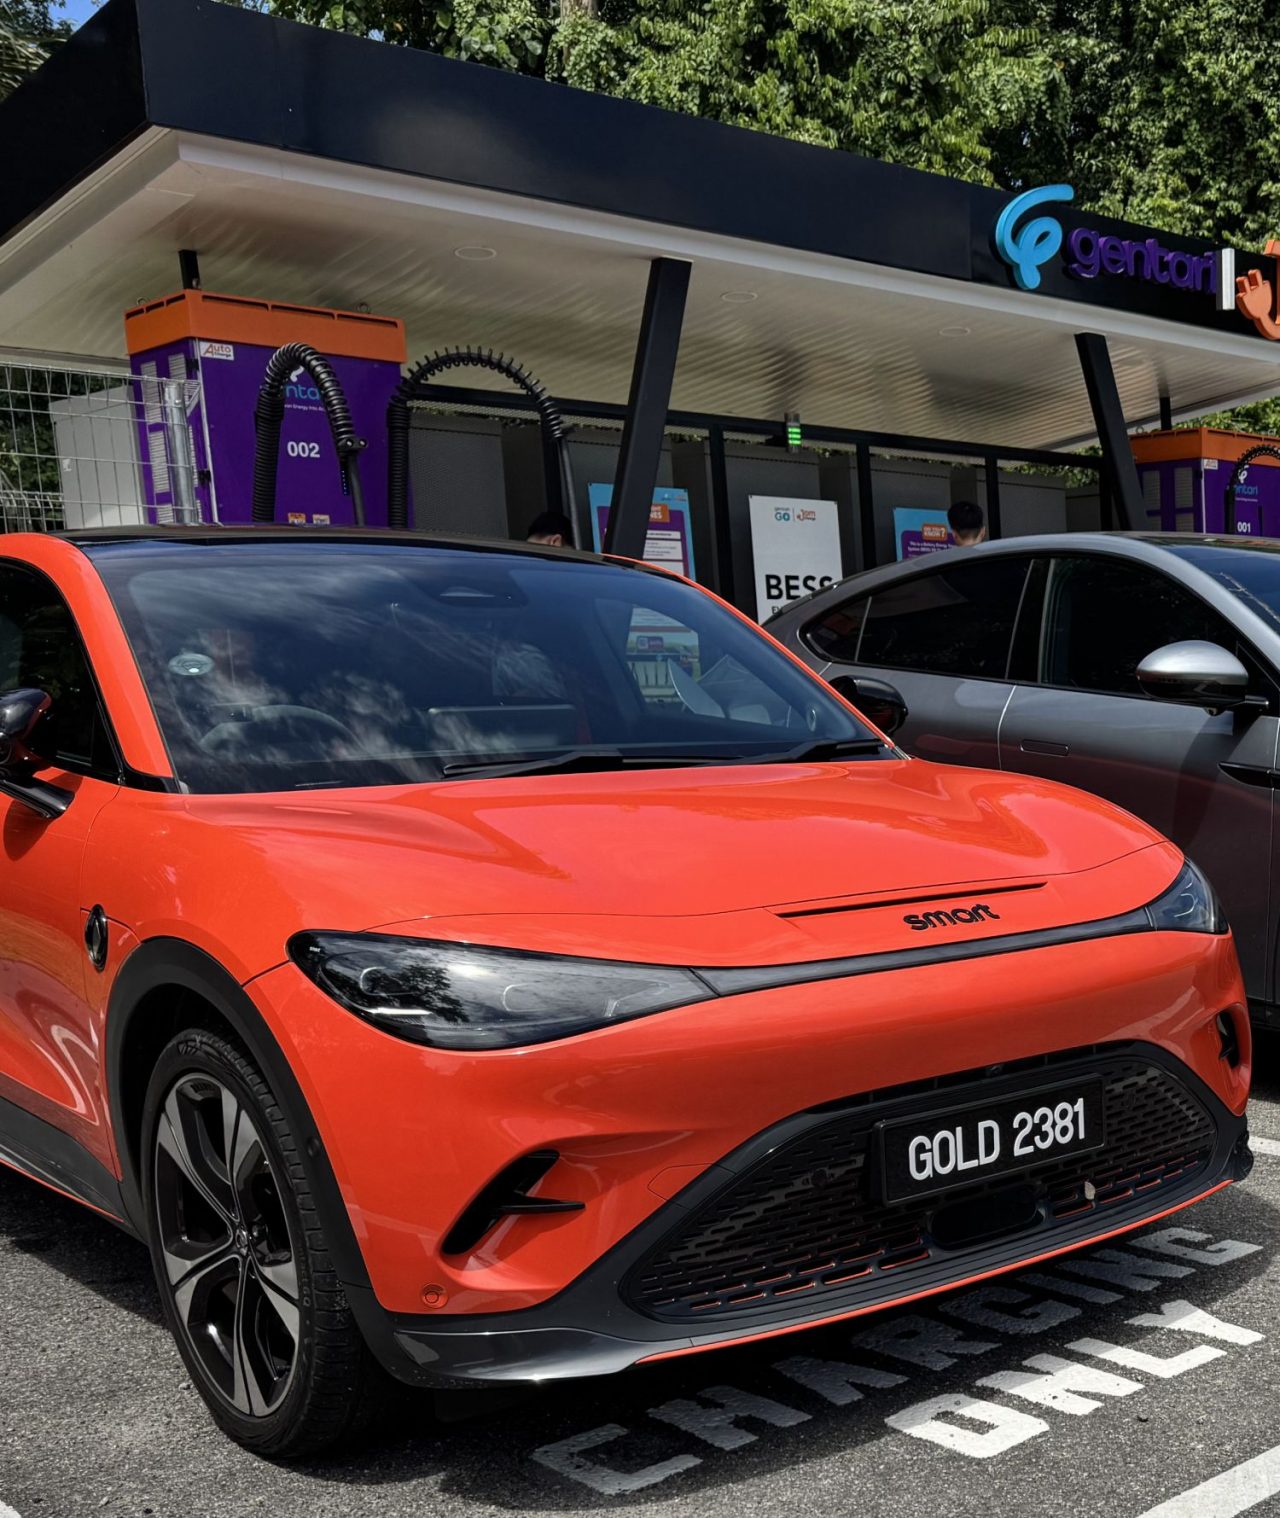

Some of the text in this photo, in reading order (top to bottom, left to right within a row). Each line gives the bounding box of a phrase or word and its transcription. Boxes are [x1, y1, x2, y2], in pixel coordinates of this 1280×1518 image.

[1068, 226, 1217, 294] gentari
[203, 343, 231, 356] Auto
[287, 441, 320, 458] 002
[1237, 522, 1251, 533] 001
[903, 903, 1000, 931] smart
[908, 1097, 1086, 1181] GOLD 2381
[530, 1226, 1264, 1496] CHARGING
[883, 1299, 1265, 1459] ONLY
